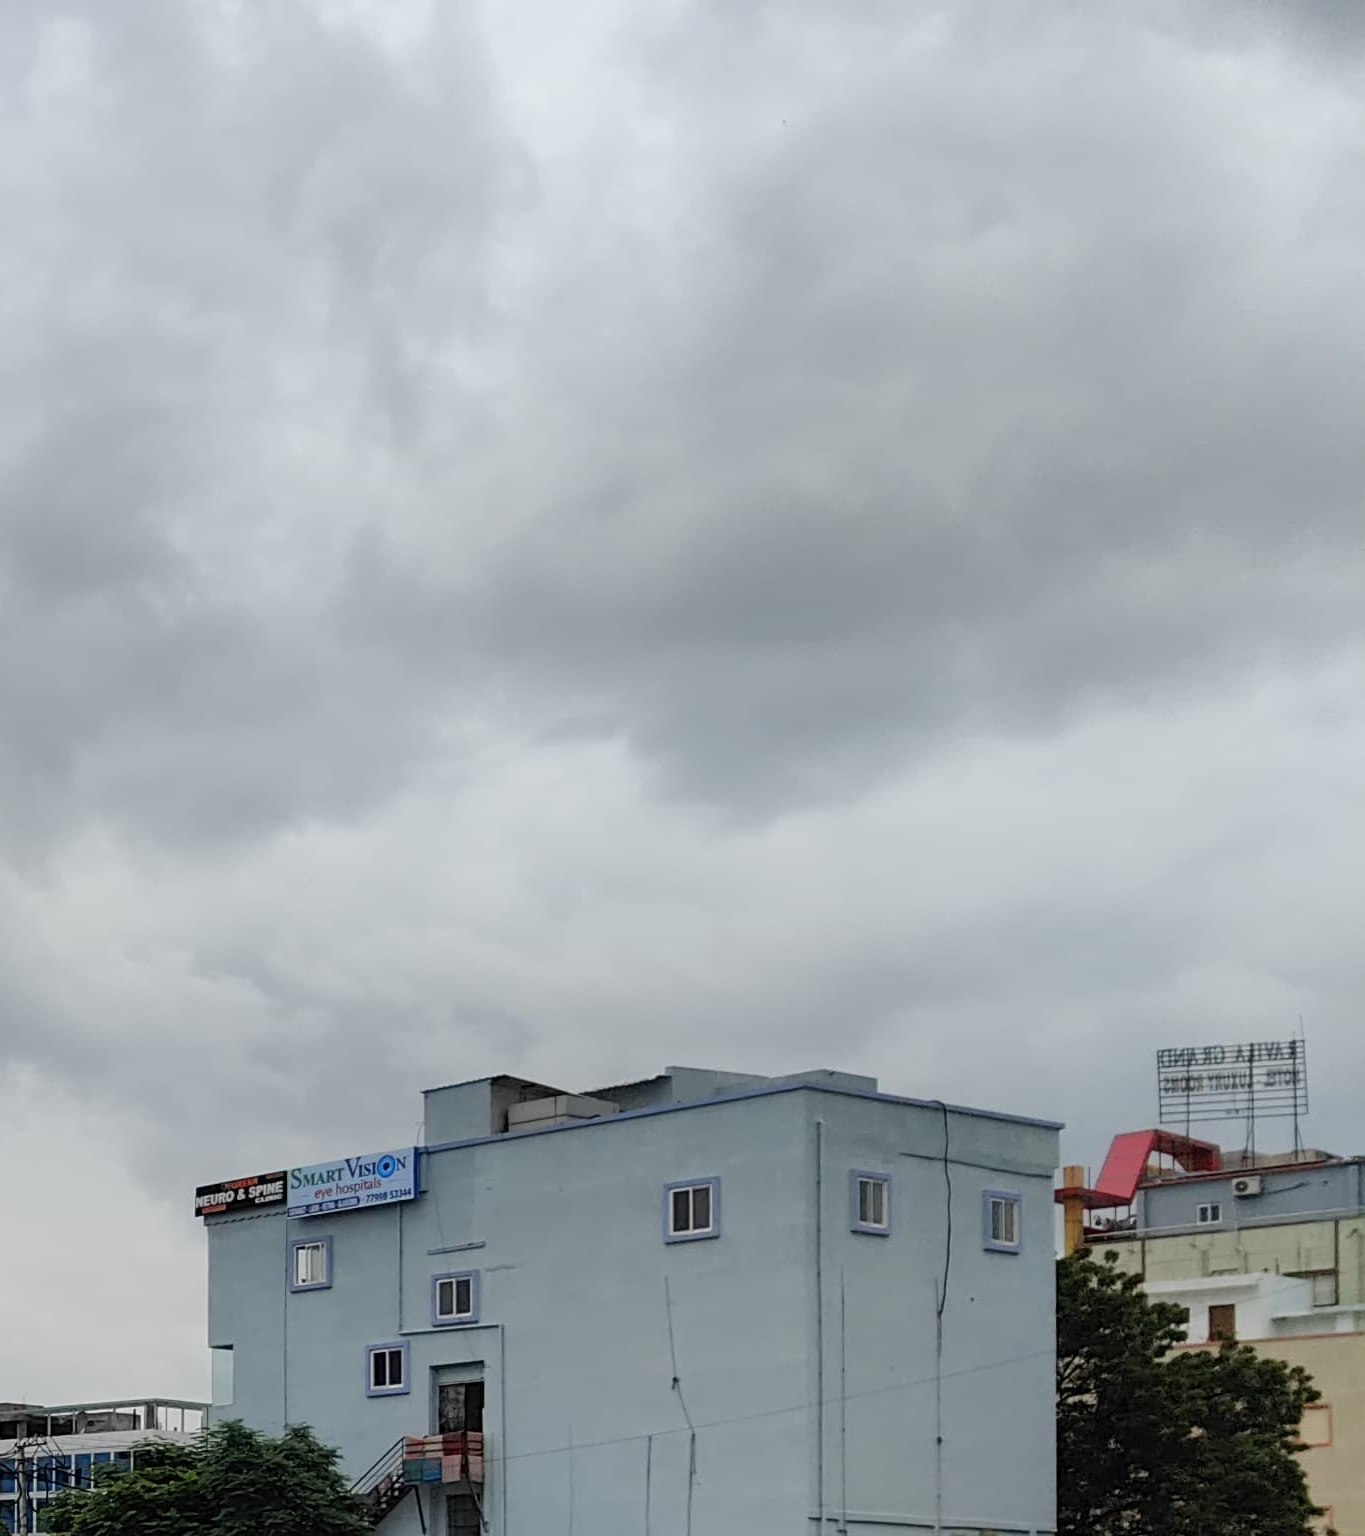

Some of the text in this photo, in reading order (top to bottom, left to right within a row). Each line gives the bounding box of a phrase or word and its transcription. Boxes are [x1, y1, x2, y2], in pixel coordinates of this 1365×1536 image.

[195, 1190, 235, 1209] NEURO
[236, 1188, 246, 1201] &
[248, 1181, 284, 1198] SPINE
[314, 1177, 381, 1200] eye hospitals
